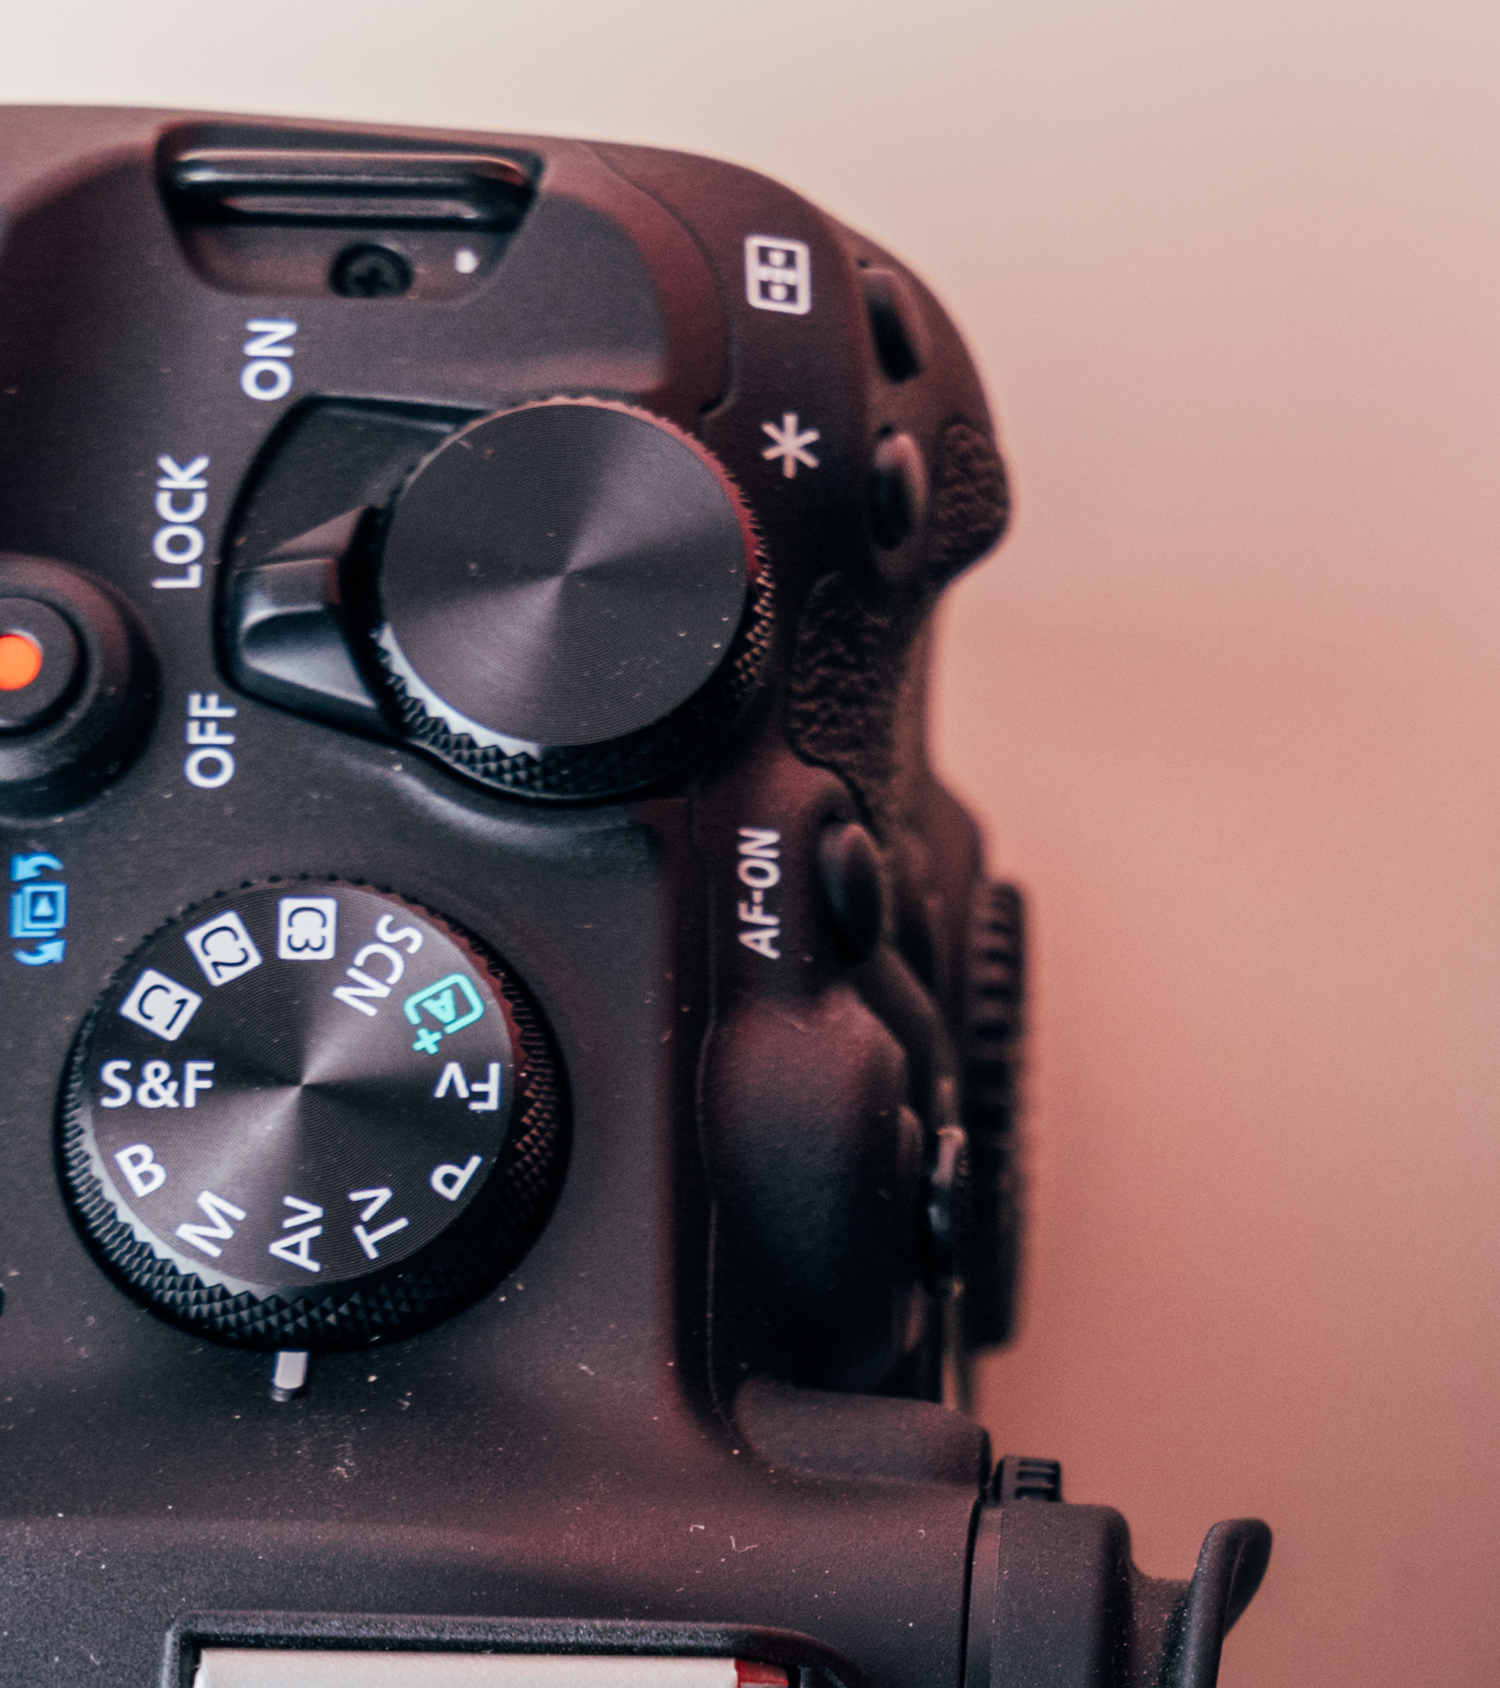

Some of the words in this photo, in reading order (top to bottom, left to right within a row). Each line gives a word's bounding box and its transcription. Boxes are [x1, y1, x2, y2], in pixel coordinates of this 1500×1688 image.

[239, 318, 298, 402] ON
[152, 454, 211, 589] LOCK
[183, 693, 238, 789] OFF
[737, 828, 781, 960] AF-ON
[198, 925, 251, 979] C2
[287, 906, 328, 953] C3
[332, 913, 425, 1017] SCN
[136, 983, 188, 1033] C1
[99, 1059, 216, 1109] S&F
[113, 1142, 168, 1199] B
[428, 1154, 483, 1202] P
[174, 1189, 248, 1259] M
